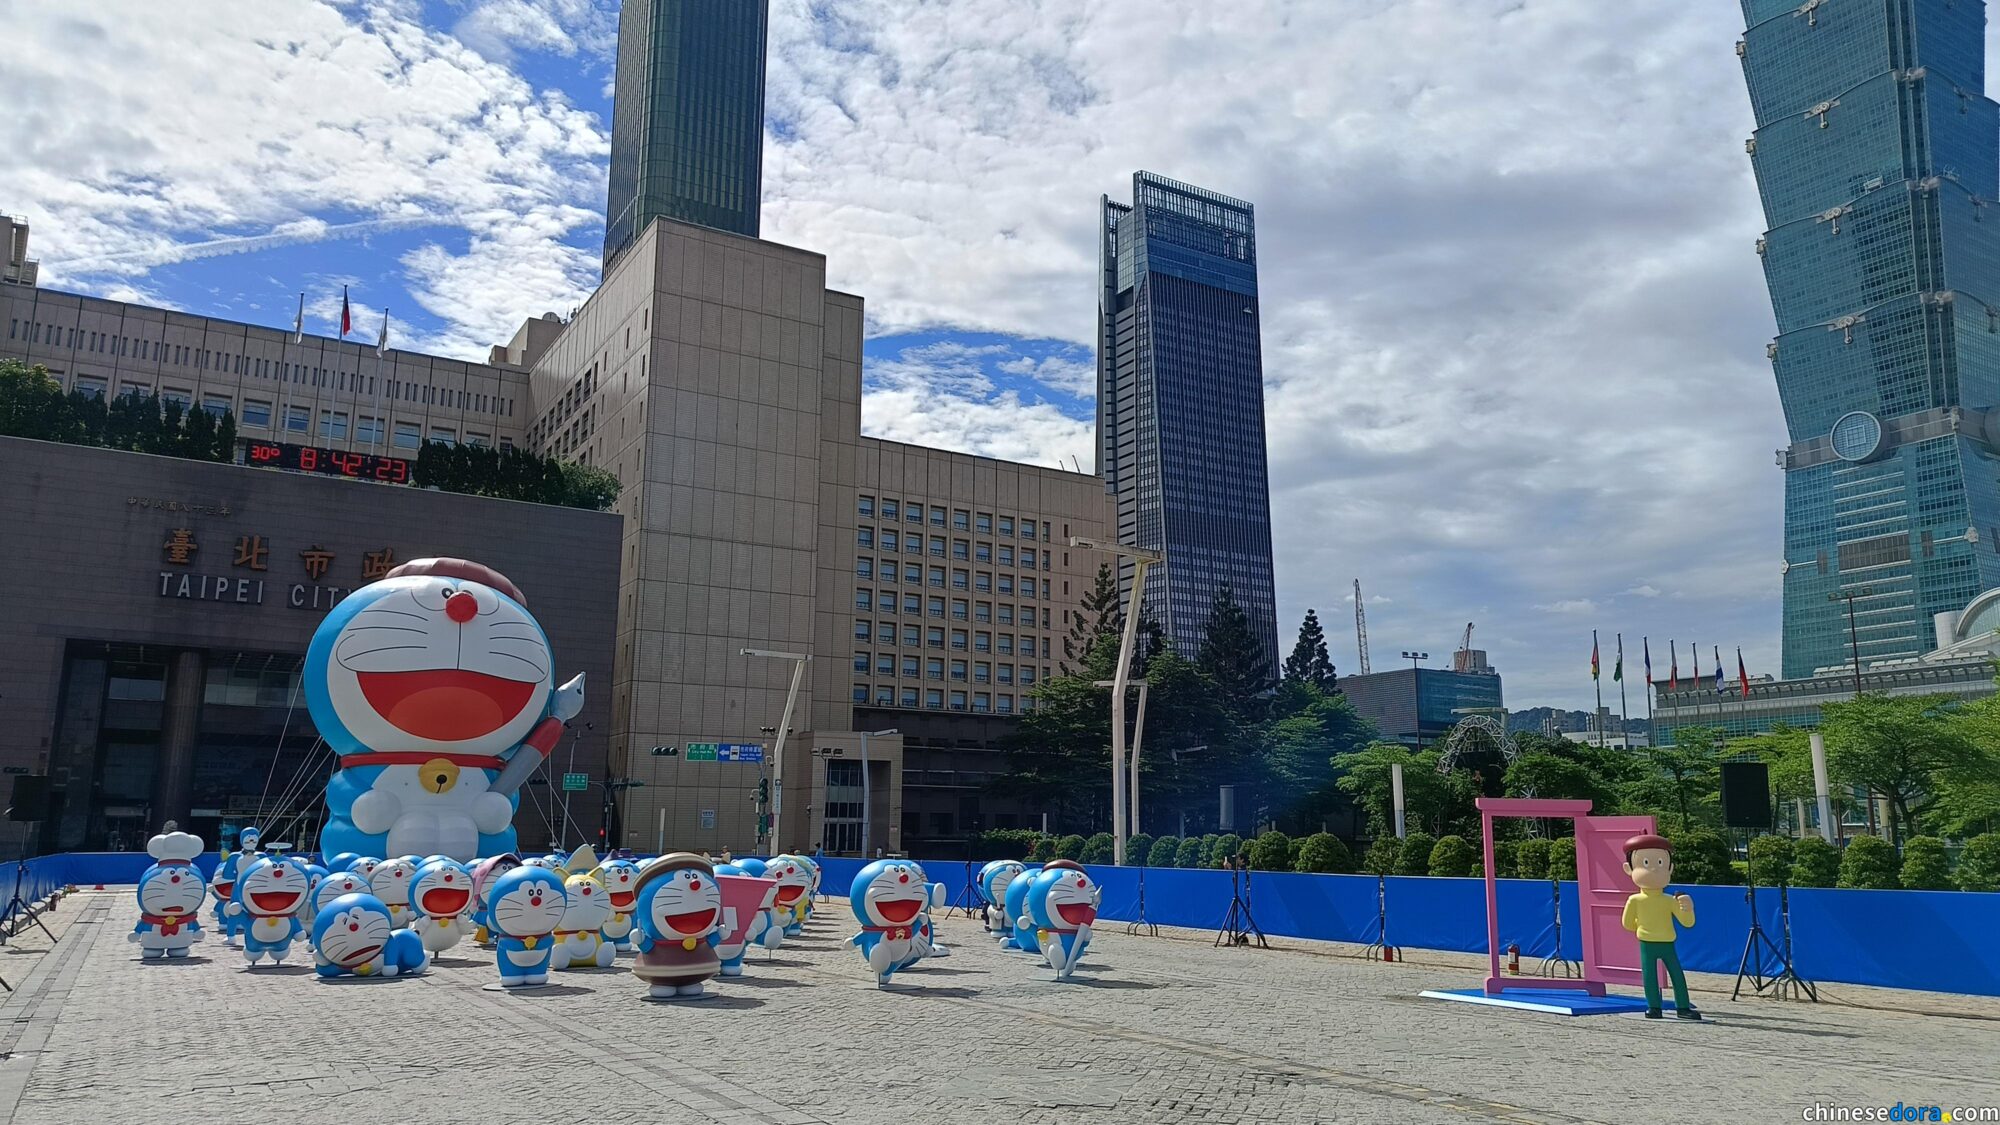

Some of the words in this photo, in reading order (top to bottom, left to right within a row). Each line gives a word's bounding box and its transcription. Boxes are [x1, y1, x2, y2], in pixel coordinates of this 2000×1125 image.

[301, 447, 406, 482] 8:42:23
[160, 572, 265, 604] TAIPEI
[291, 584, 353, 609] CIT
